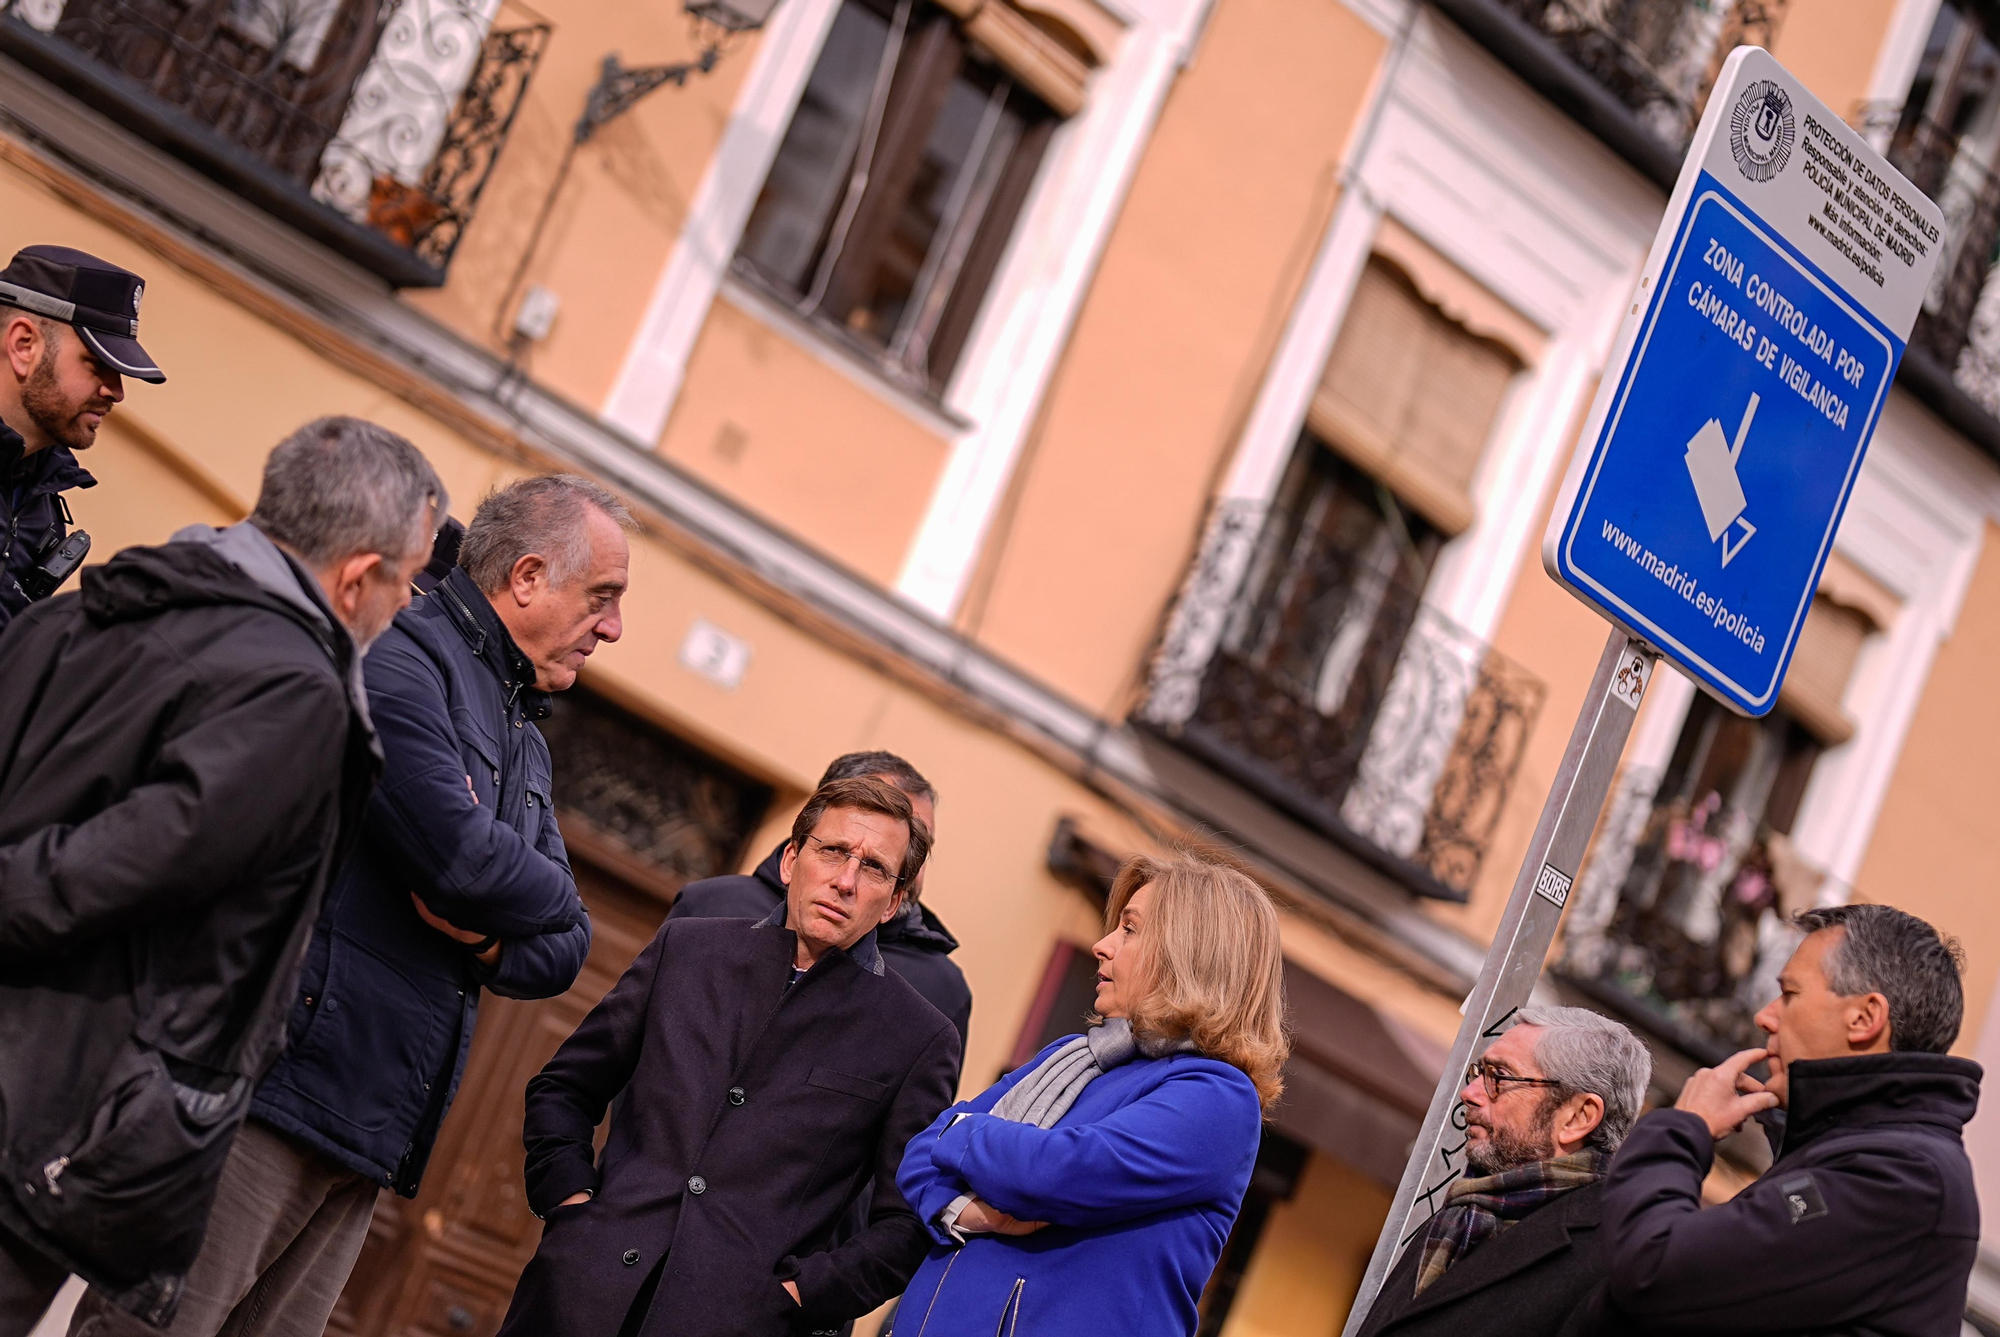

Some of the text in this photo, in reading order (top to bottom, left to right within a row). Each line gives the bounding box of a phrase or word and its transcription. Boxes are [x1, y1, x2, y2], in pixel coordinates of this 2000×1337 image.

[1801, 136, 1852, 186] Responsable
[1852, 182, 1884, 217] atención
[1883, 209, 1895, 227] de
[1893, 217, 1929, 258] derechos:
[1802, 160, 1916, 268] POLICÍA MUNICIPAL DE MADRID
[1803, 114, 1940, 244] PROTECCIÓN DE DATOS PERSONALES
[1822, 201, 1884, 263] Más información:
[1688, 281, 1850, 431] CÁMARAS DE VIGILANCIA
[1703, 237, 1865, 389] ZONA CONTROLADA POR
[1601, 519, 1766, 655] www.madrid.es/policia
